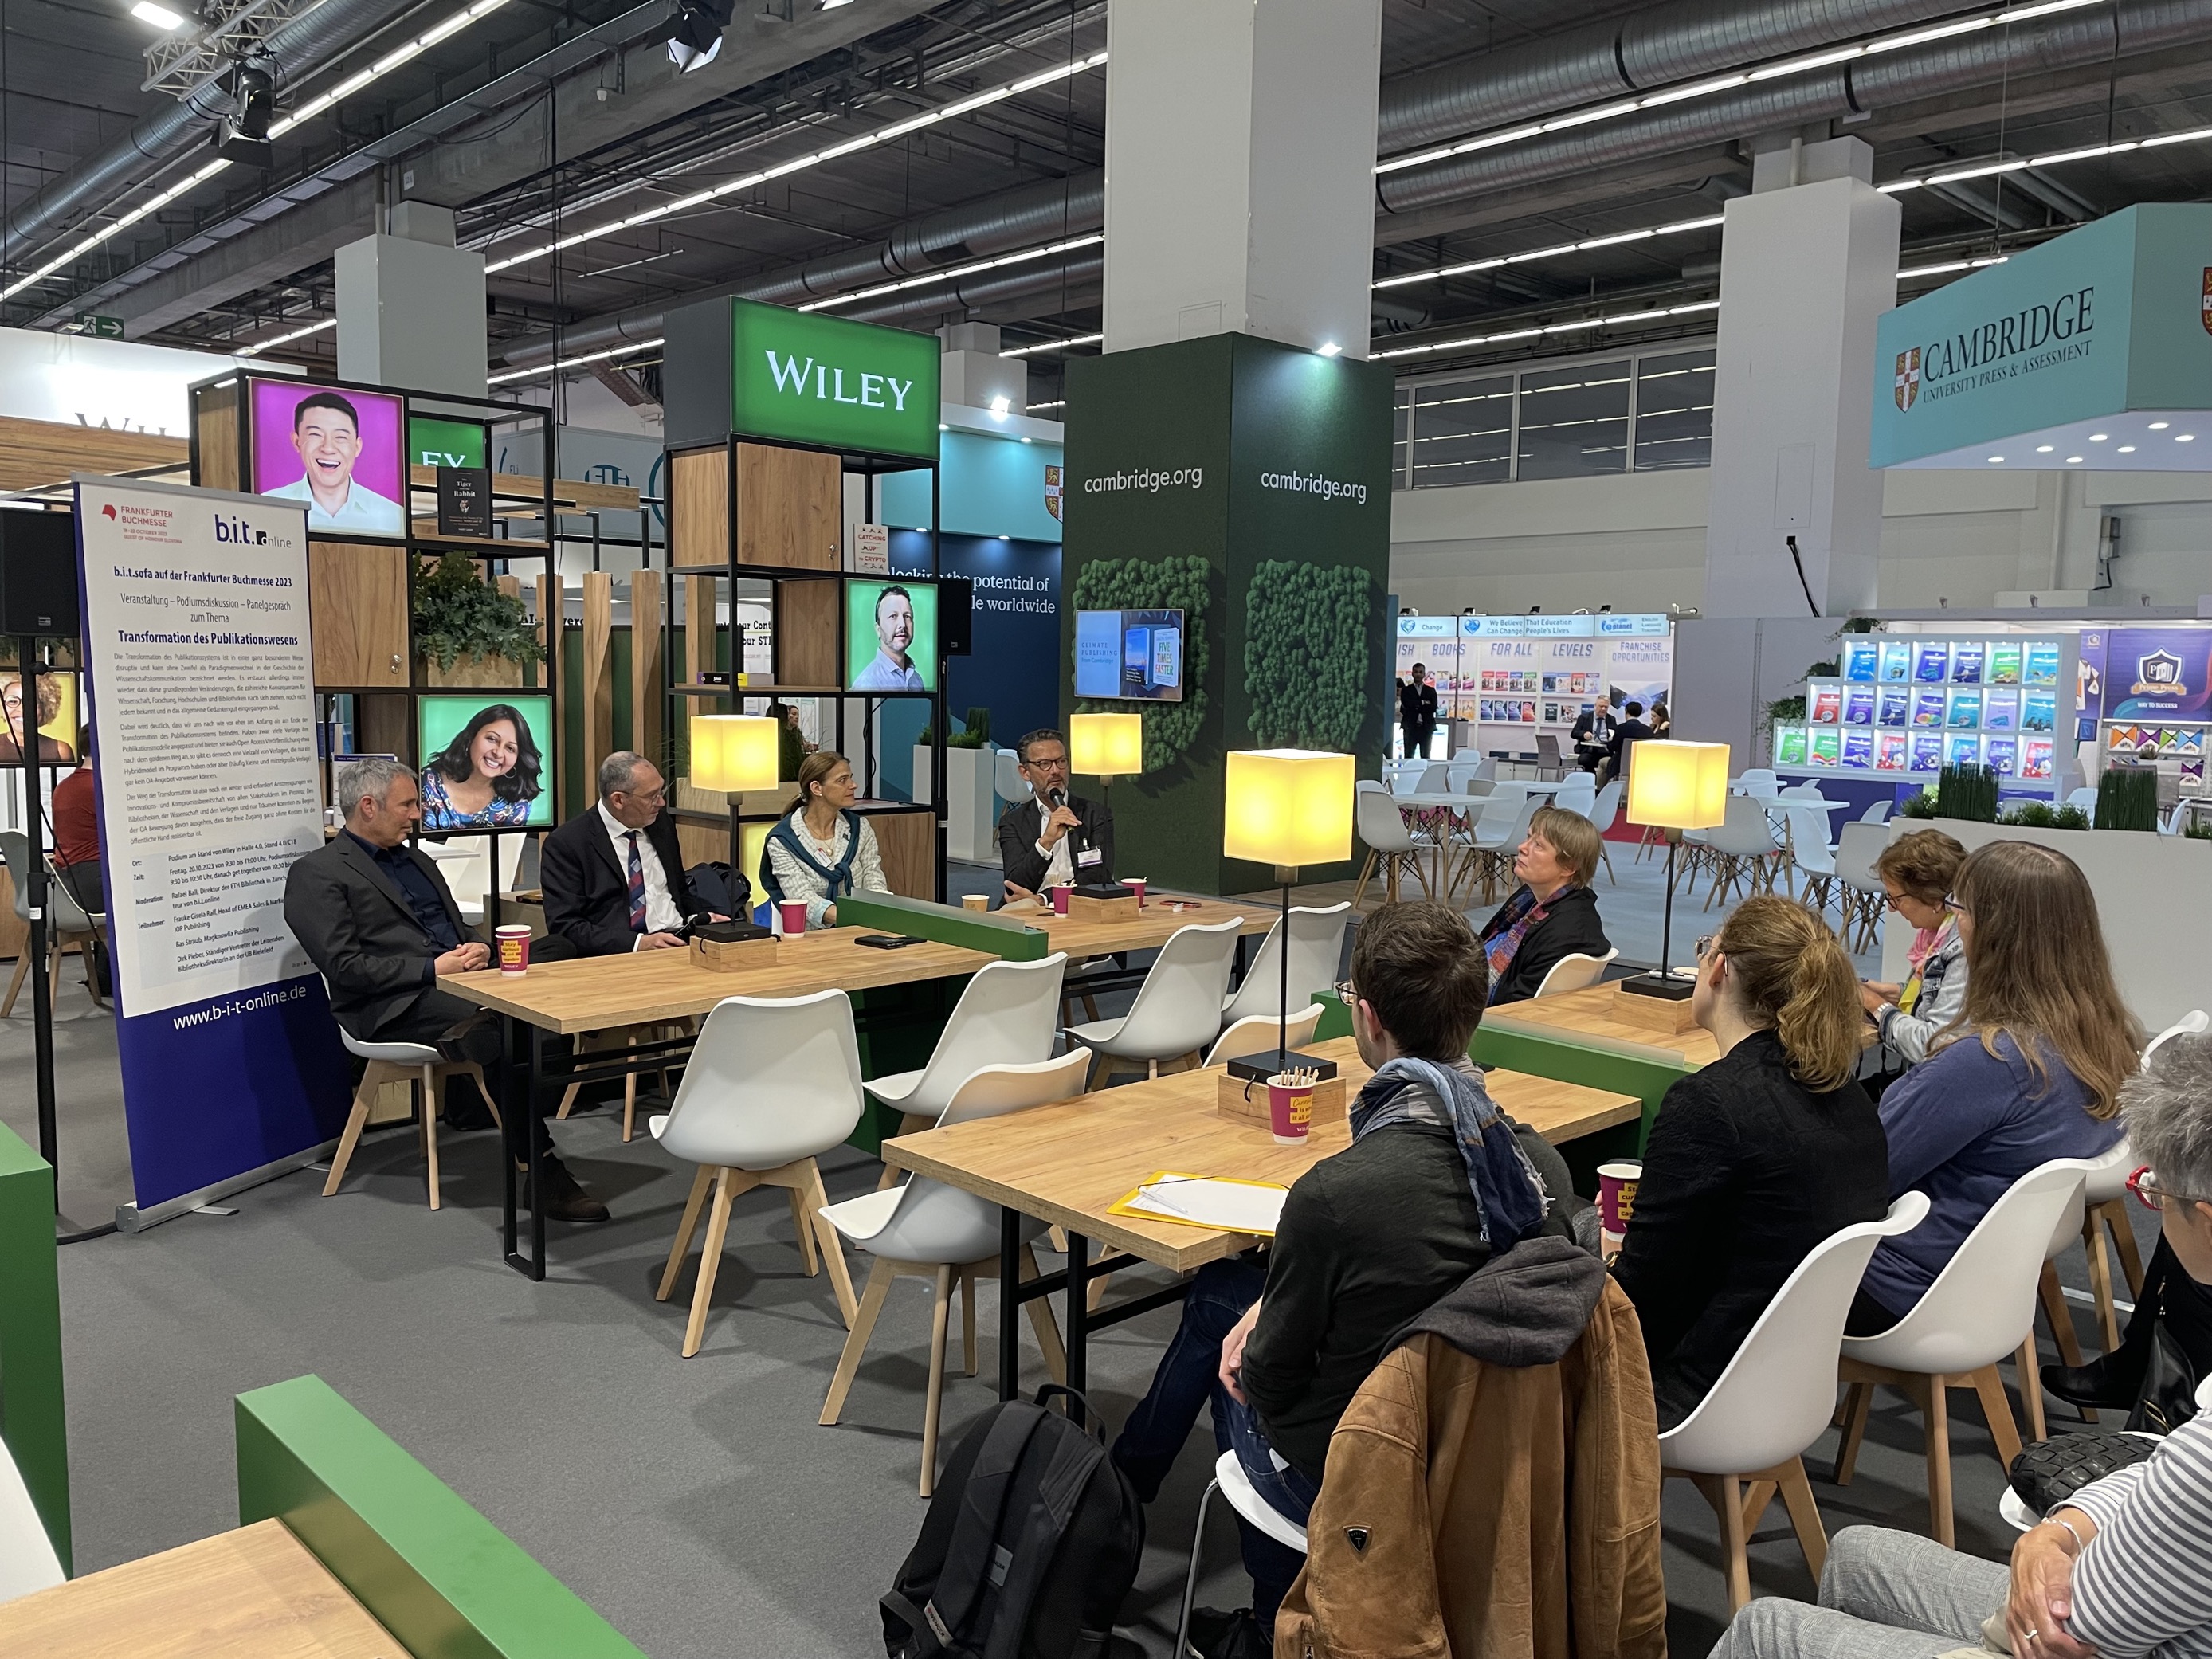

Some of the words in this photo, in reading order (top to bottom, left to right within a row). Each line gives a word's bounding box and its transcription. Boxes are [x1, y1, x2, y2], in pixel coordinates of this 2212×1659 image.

[1924, 287, 2094, 382] CAMBRIDGE
[1923, 375, 1977, 403] UNIVERSITY
[1980, 366, 2006, 390] PRESS
[2010, 363, 2018, 378] &
[2022, 341, 2092, 375] ASSESSMENT
[765, 350, 913, 411] WILEY
[1084, 467, 1202, 493] cambridge.org
[1261, 470, 1367, 504] cambridge.org
[121, 506, 172, 518] FRANKFURTER
[122, 516, 167, 527] BUCHMESSE
[114, 567, 152, 578] b.i.t.sofa
[155, 571, 168, 581] auf
[170, 571, 182, 581] der
[184, 571, 230, 584] Frankfurter
[232, 575, 273, 586] Buchmesse
[275, 577, 292, 587] 2023
[973, 575, 1033, 590] potential
[1037, 578, 1049, 591] of
[120, 593, 168, 607] Veranstaltung
[176, 596, 238, 609] Podiumsdiskussion
[247, 599, 291, 611] Panelgespräch
[987, 598, 1055, 613] worldwide
[190, 614, 205, 622] zum
[206, 612, 229, 623] Thema
[118, 630, 191, 644] Transformation
[194, 633, 209, 645] des
[210, 632, 298, 646] Publikationswesens
[1159, 642, 1170, 652] FIVE
[1433, 644, 1466, 655] BOOKS
[1491, 643, 1512, 655] FOR
[1515, 643, 1532, 655] ALL
[1553, 644, 1593, 656] LEVELS
[1621, 642, 1661, 651] FRANCHISE
[1157, 653, 1172, 663] TIMES
[1155, 665, 1173, 676] FASTER
[168, 853, 186, 861] Podium
[222, 845, 235, 855] Wiley
[264, 840, 278, 849] Stand
[189, 863, 214, 873] 20.10.2023
[214, 869, 232, 878] danach
[171, 890, 187, 899] Rafael
[200, 884, 220, 894] Direktor
[241, 877, 265, 888] Bibliothek
[174, 914, 190, 923] Frauke
[191, 912, 206, 920] Gisela
[218, 907, 231, 916] Head
[237, 903, 252, 912] EMEA
[183, 921, 210, 931] Publishing
[234, 926, 259, 936] Publishing
[174, 985, 307, 1030] www.b-i-t-online.de
